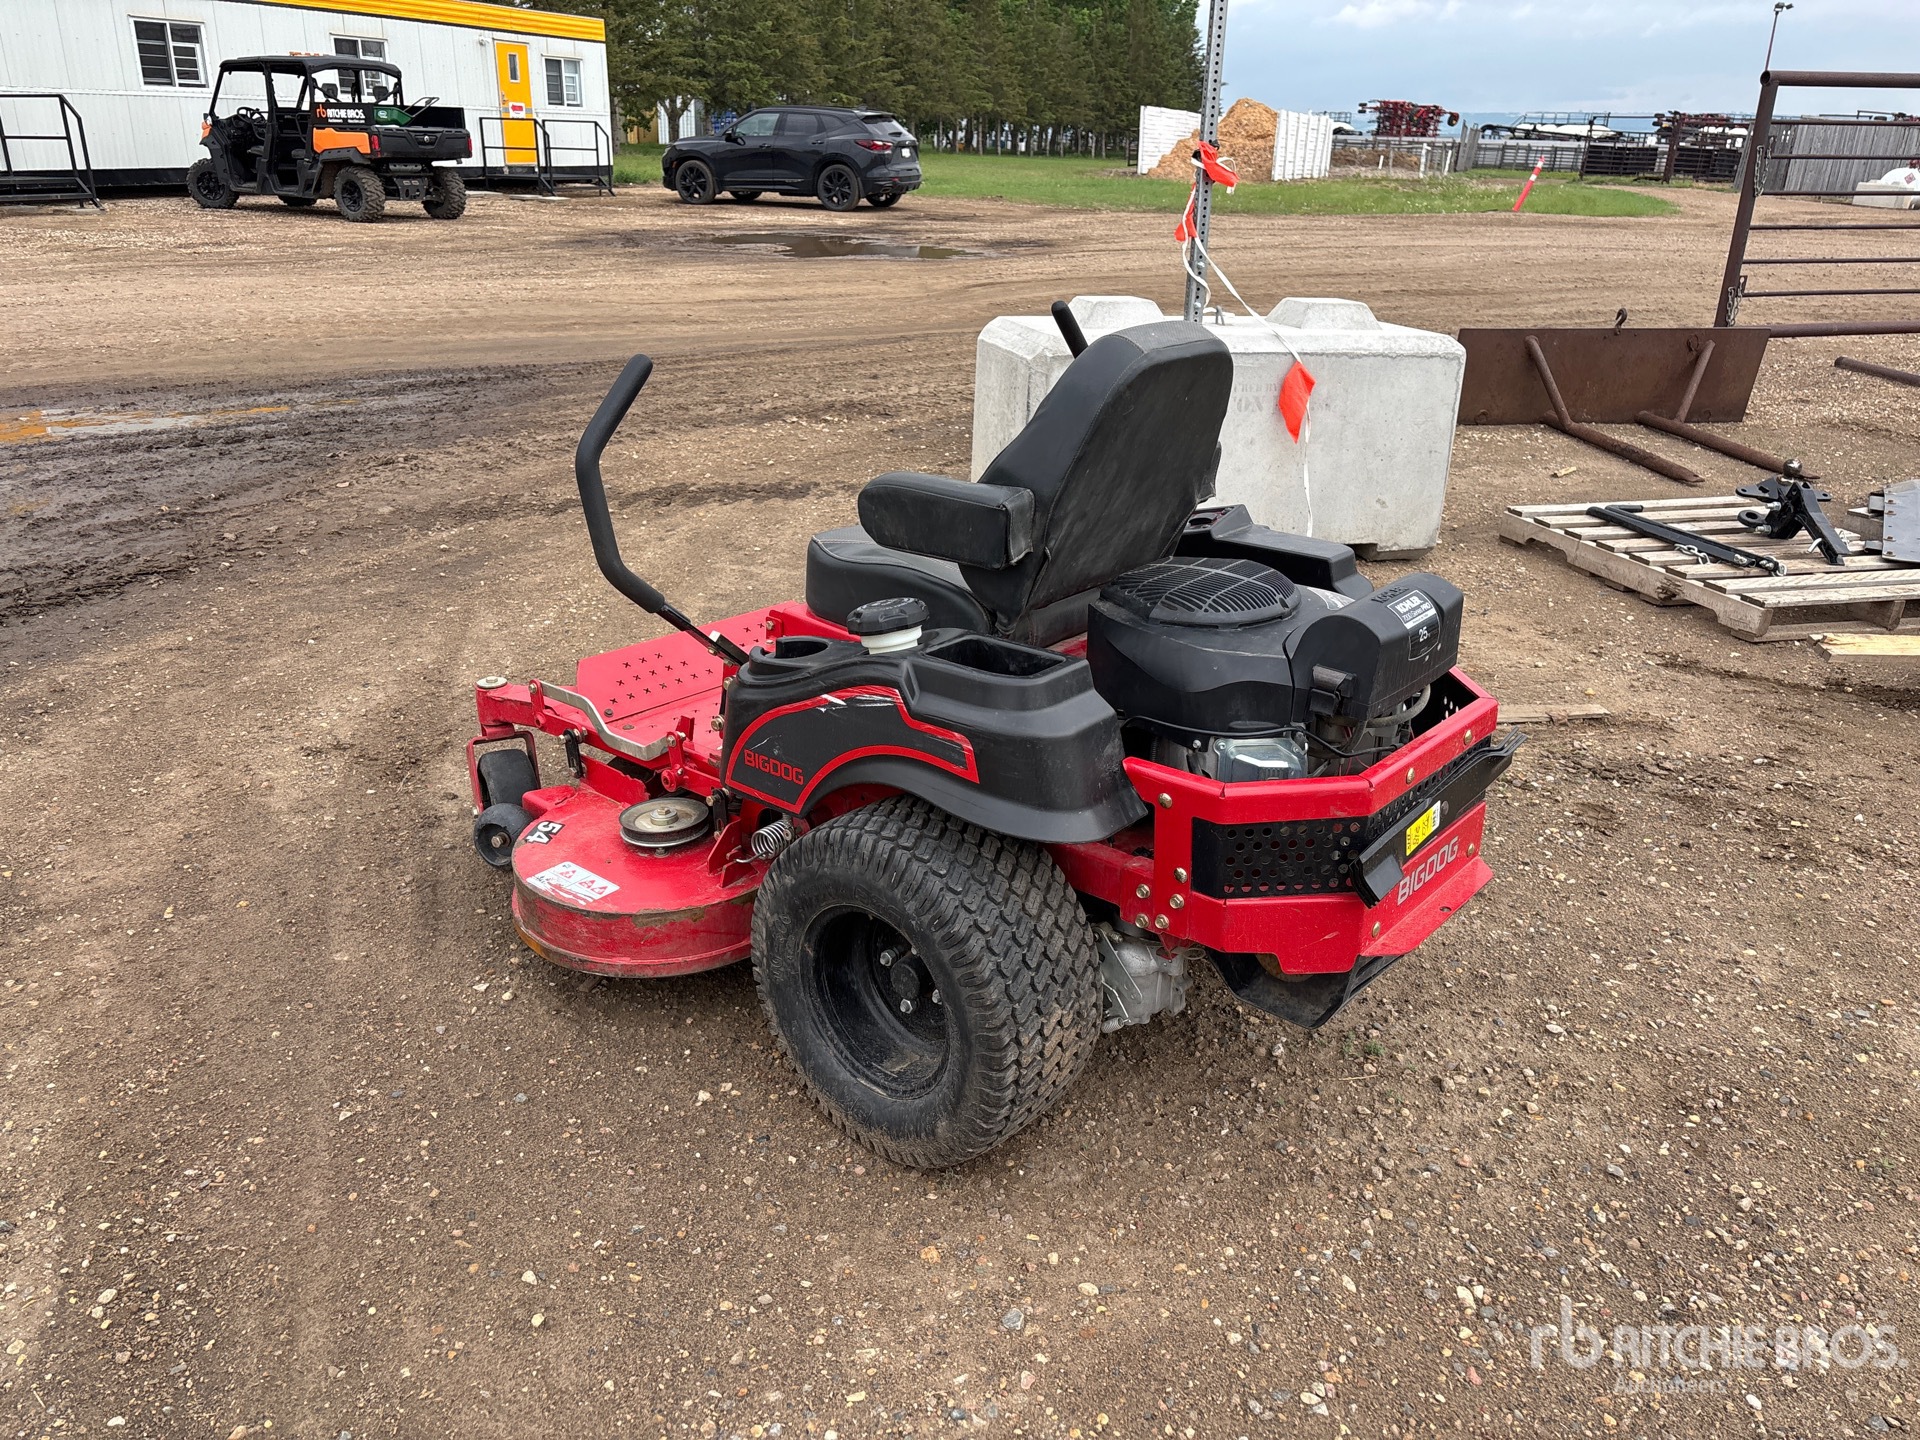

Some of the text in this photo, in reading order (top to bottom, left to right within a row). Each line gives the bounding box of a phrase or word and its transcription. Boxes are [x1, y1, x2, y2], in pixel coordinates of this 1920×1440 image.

[327, 108, 347, 118] RITCHIE
[1395, 596, 1424, 614] KOHLER
[1419, 626, 1428, 642] 25
[744, 749, 804, 785] BIGDOG
[525, 821, 563, 844] 54
[1397, 836, 1459, 906] BIGDOG
